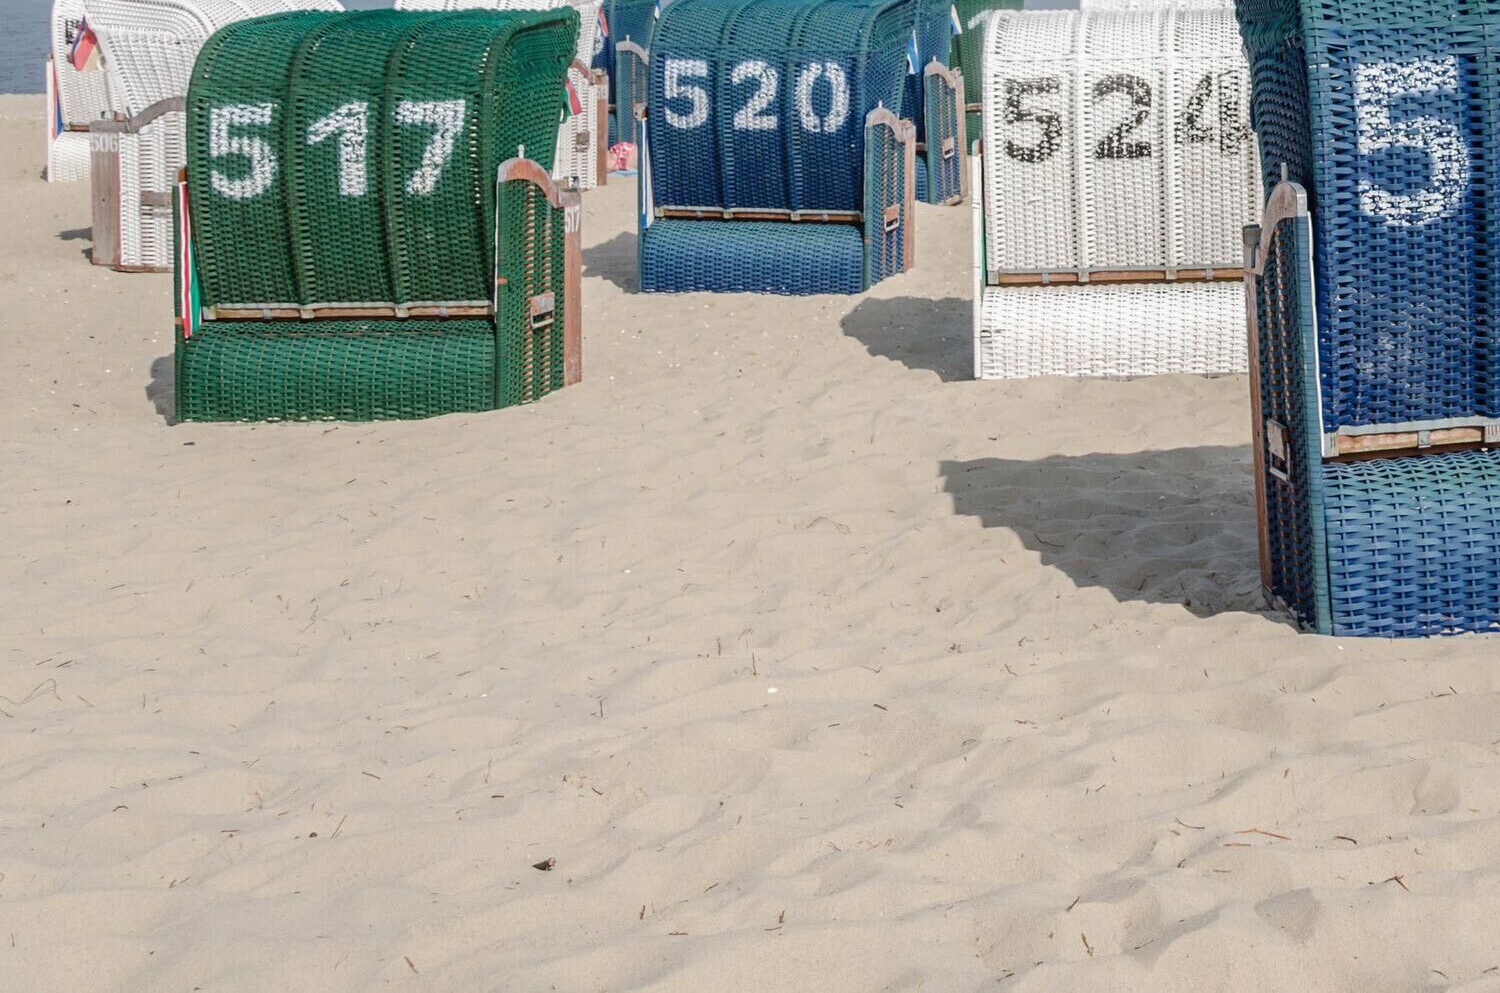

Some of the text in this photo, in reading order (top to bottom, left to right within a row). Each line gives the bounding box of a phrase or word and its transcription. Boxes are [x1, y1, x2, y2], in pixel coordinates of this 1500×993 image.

[664, 59, 849, 133] 520
[1004, 70, 1252, 163] 524
[91, 134, 118, 152] 506
[209, 99, 466, 200] 517
[564, 206, 580, 233] 517
